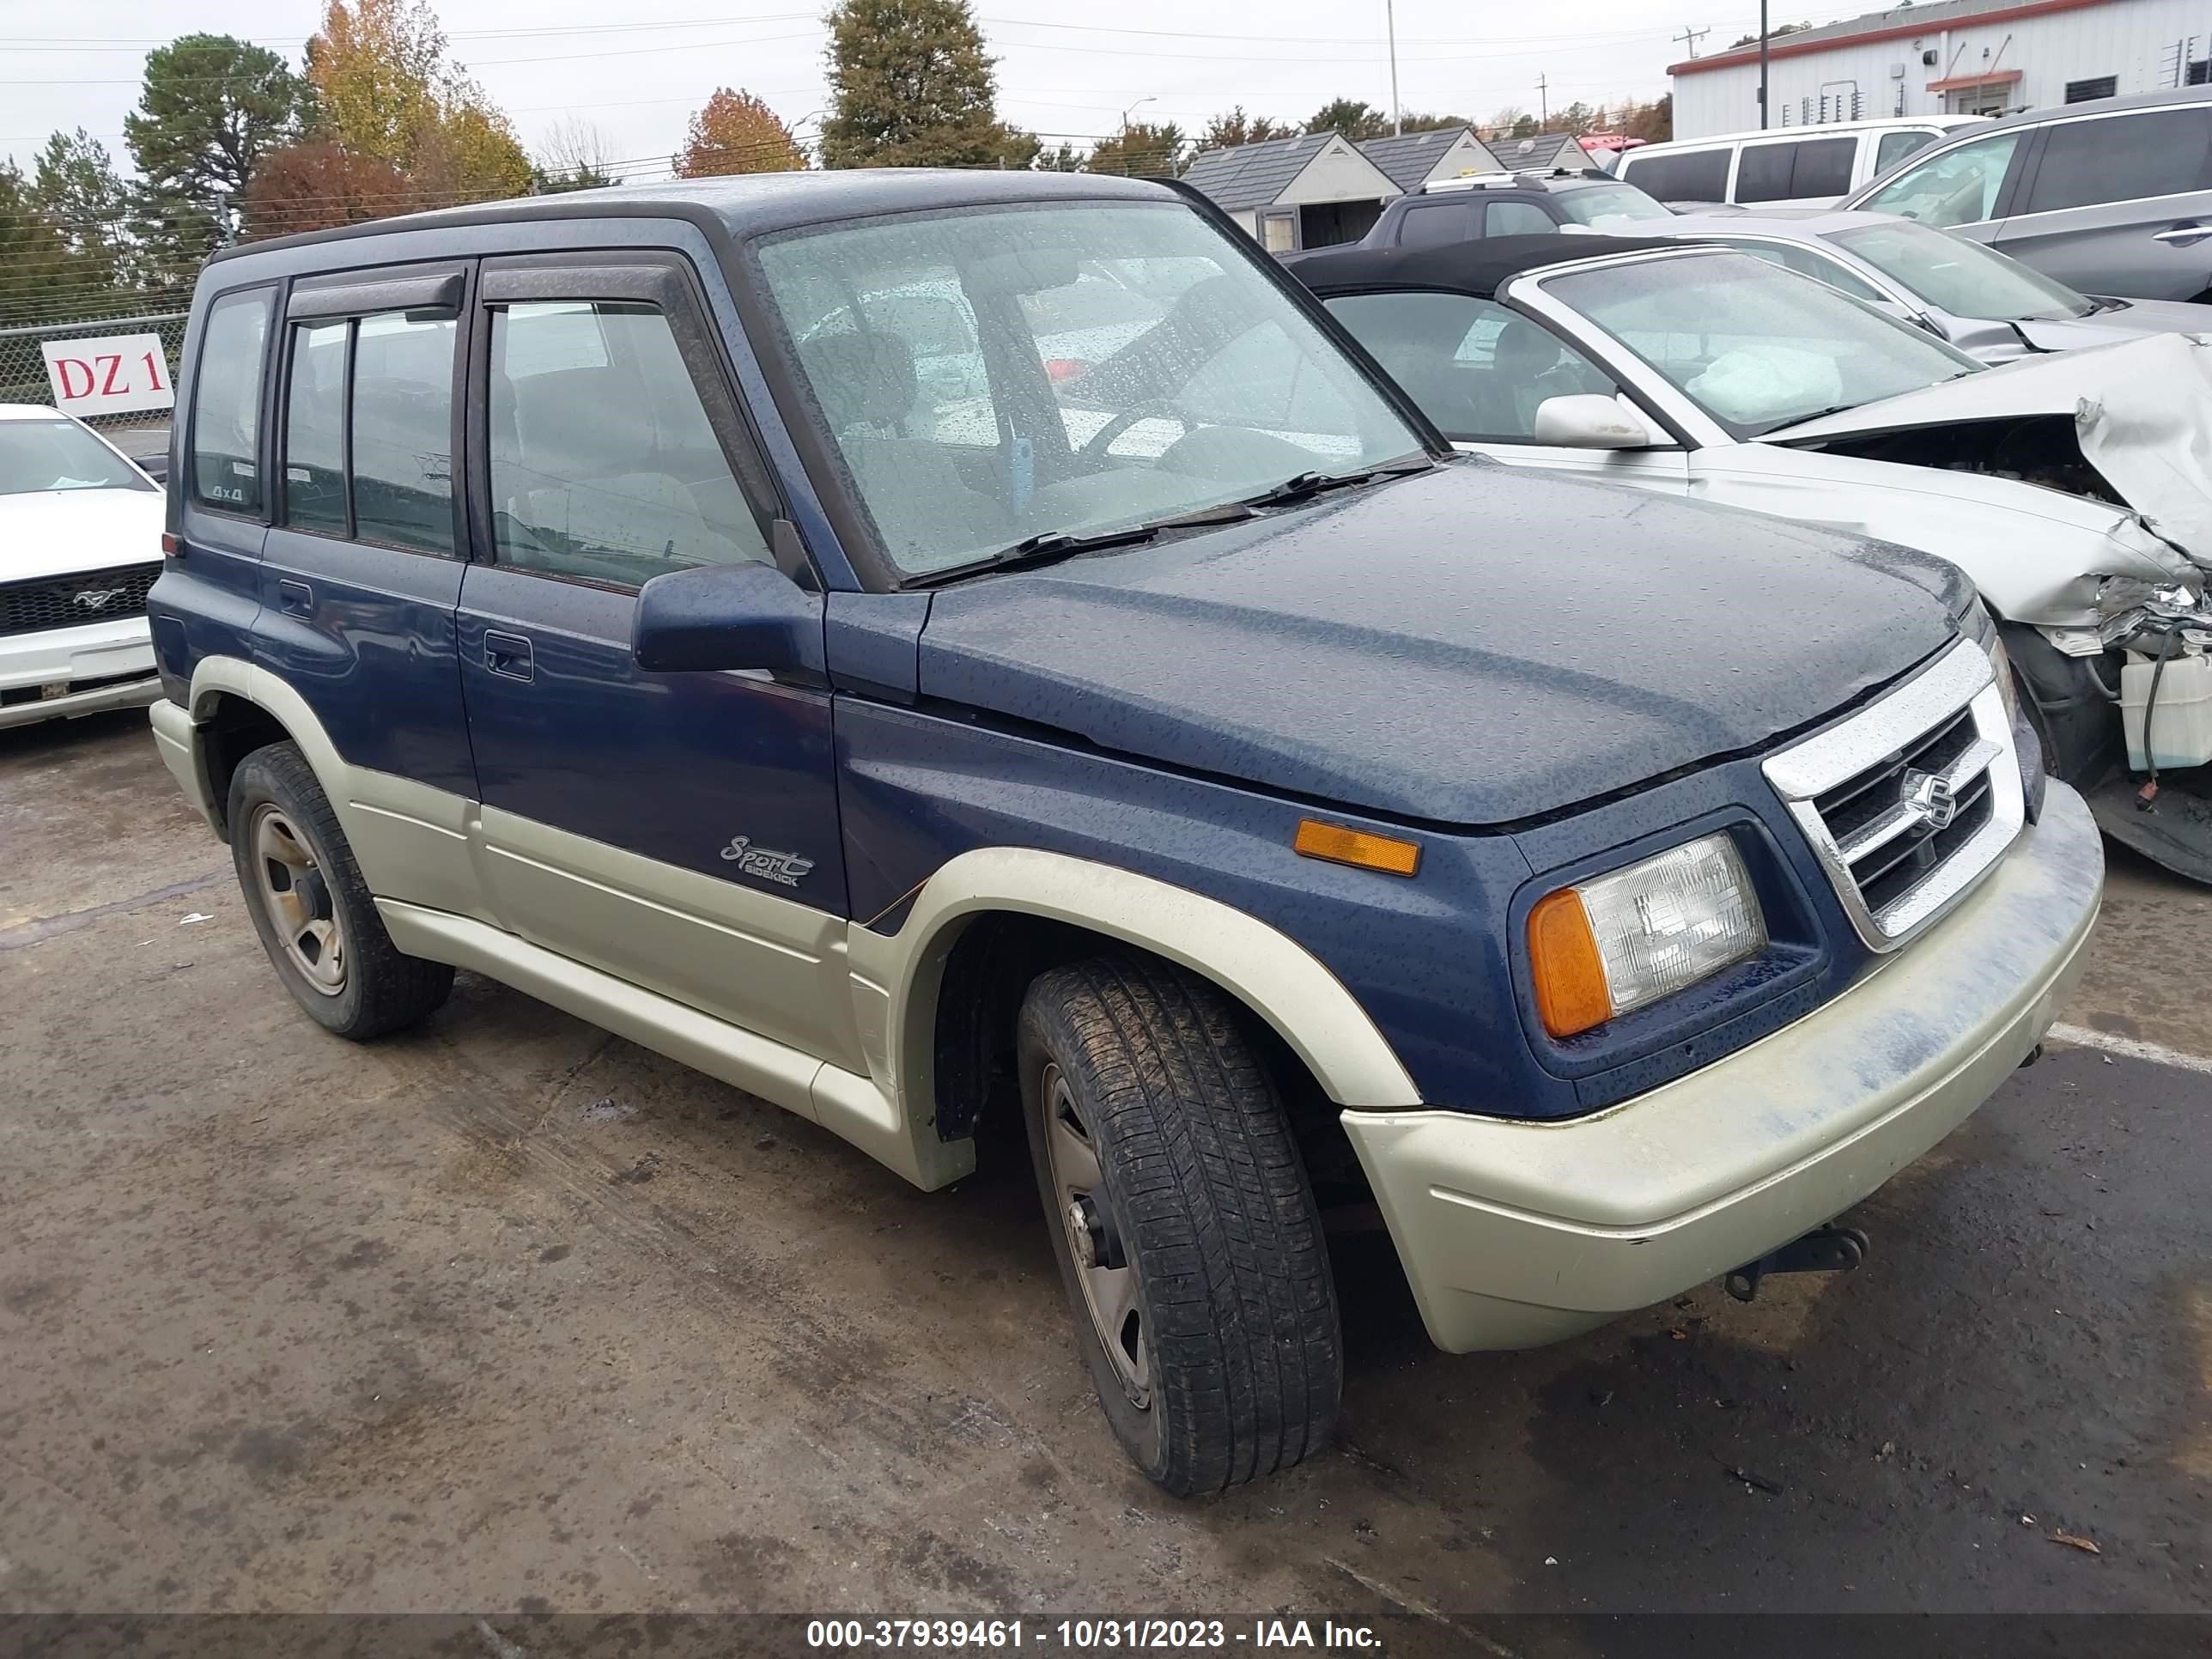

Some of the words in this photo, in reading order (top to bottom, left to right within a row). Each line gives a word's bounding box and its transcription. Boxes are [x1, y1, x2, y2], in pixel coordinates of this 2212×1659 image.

[52, 355, 131, 400] DZ
[141, 350, 166, 392] 1
[720, 834, 815, 876] Sport
[744, 864, 799, 887] SIDEKICK
